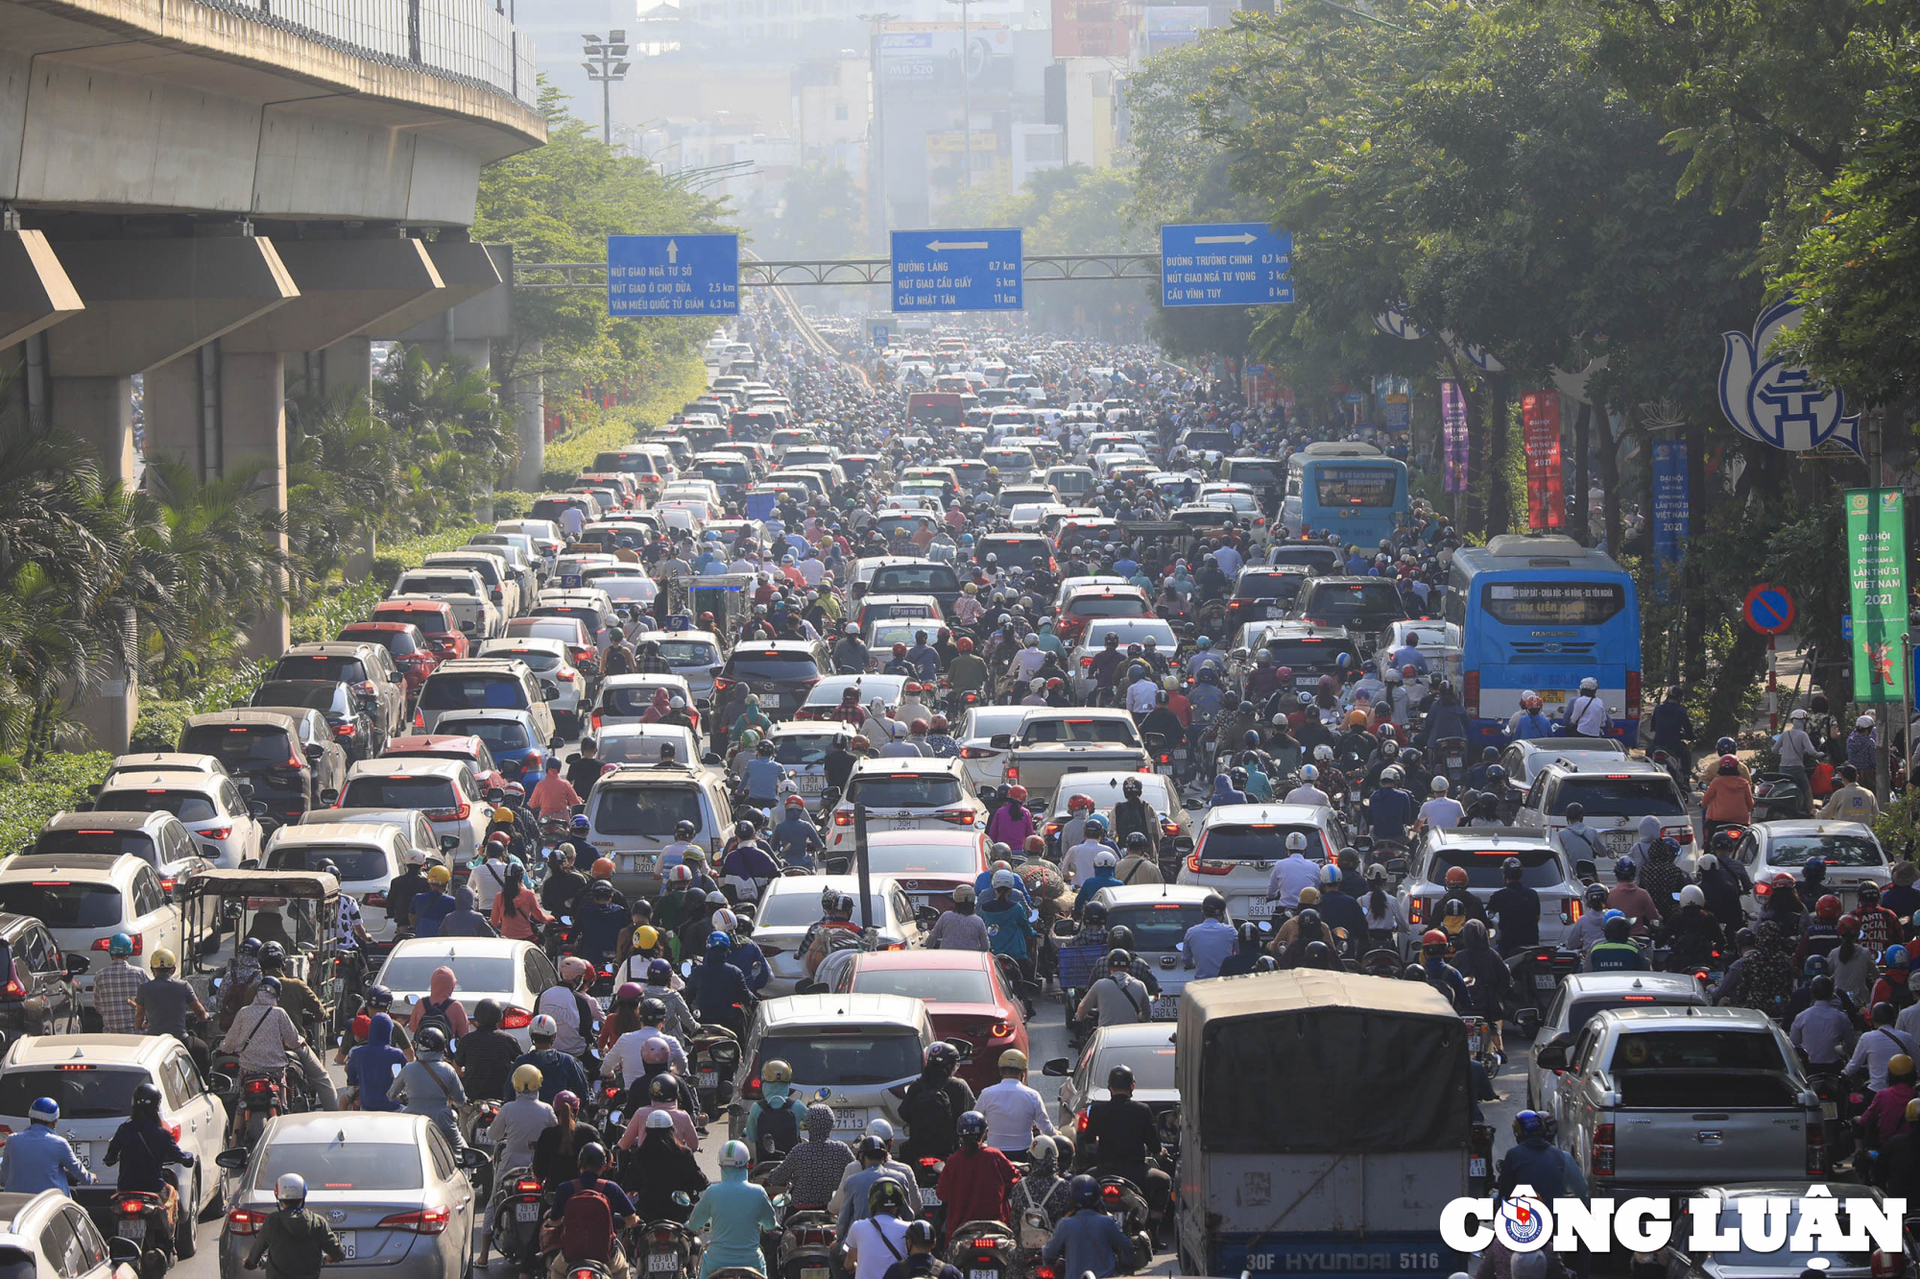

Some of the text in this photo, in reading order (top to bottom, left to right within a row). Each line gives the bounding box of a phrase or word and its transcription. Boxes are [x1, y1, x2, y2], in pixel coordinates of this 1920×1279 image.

[1166, 253, 1193, 266] ĐƯỜNG
[1196, 253, 1226, 265] TRƯỜNG
[1230, 255, 1253, 265] CHINH
[1276, 254, 1288, 263] km
[611, 265, 626, 276] NÚT
[629, 267, 646, 276] GIAO
[649, 265, 664, 276] NGÃ
[668, 266, 678, 276] TƯ
[898, 260, 925, 272] ĐƯỜNG
[928, 259, 948, 272] LÁNG
[1003, 261, 1015, 270] km
[899, 276, 1016, 288] NÚT GIAO CẦU GIẤY 5 km
[1167, 271, 1182, 283] NÚT
[1185, 273, 1202, 282] GIAO
[1204, 271, 1220, 282] NGÃ
[1222, 272, 1233, 282] TƯ
[1235, 271, 1256, 283] VỌNG
[1268, 271, 1274, 280] 3
[611, 281, 626, 293] NÚT
[629, 284, 646, 293] GIAO
[657, 284, 672, 294] CHỢ
[723, 283, 735, 292] km
[1167, 287, 1183, 300] CẦU
[1186, 287, 1204, 299] VĨNH
[1269, 288, 1274, 297] 8
[1277, 287, 1289, 296] km
[612, 298, 627, 310] VĂN
[629, 297, 648, 310] MIẾU
[650, 297, 670, 310] QUỐC
[685, 297, 704, 309] GIÁM
[723, 299, 735, 309] km
[899, 294, 1016, 306] CẦU NHẬT TÂN 11 km
[1527, 449, 1541, 458] VIỆT
[1535, 458, 1551, 467] 2021
[1656, 501, 1668, 509] LẦN
[1656, 510, 1670, 520] VIỆT
[1663, 523, 1683, 531] 2021
[1858, 531, 1891, 543] ĐẠI HỘI
[1854, 566, 1871, 576] LẦN
[1872, 566, 1889, 575] THỨ
[1854, 578, 1901, 591] VIỆT NAM
[1865, 594, 1892, 605] 2021
[1613, 834, 1626, 842] 29A
[1861, 913, 1882, 922] ANTI
[1861, 921, 1887, 930] OCIAL
[1862, 930, 1888, 940] OCIAL
[1860, 941, 1883, 951] CLUB
[1161, 999, 1177, 1008] 30A
[837, 1110, 855, 1119] 30G
[652, 1262, 676, 1270] 193.45
[1246, 1253, 1440, 1271] 30F HYUNDAI 5116
